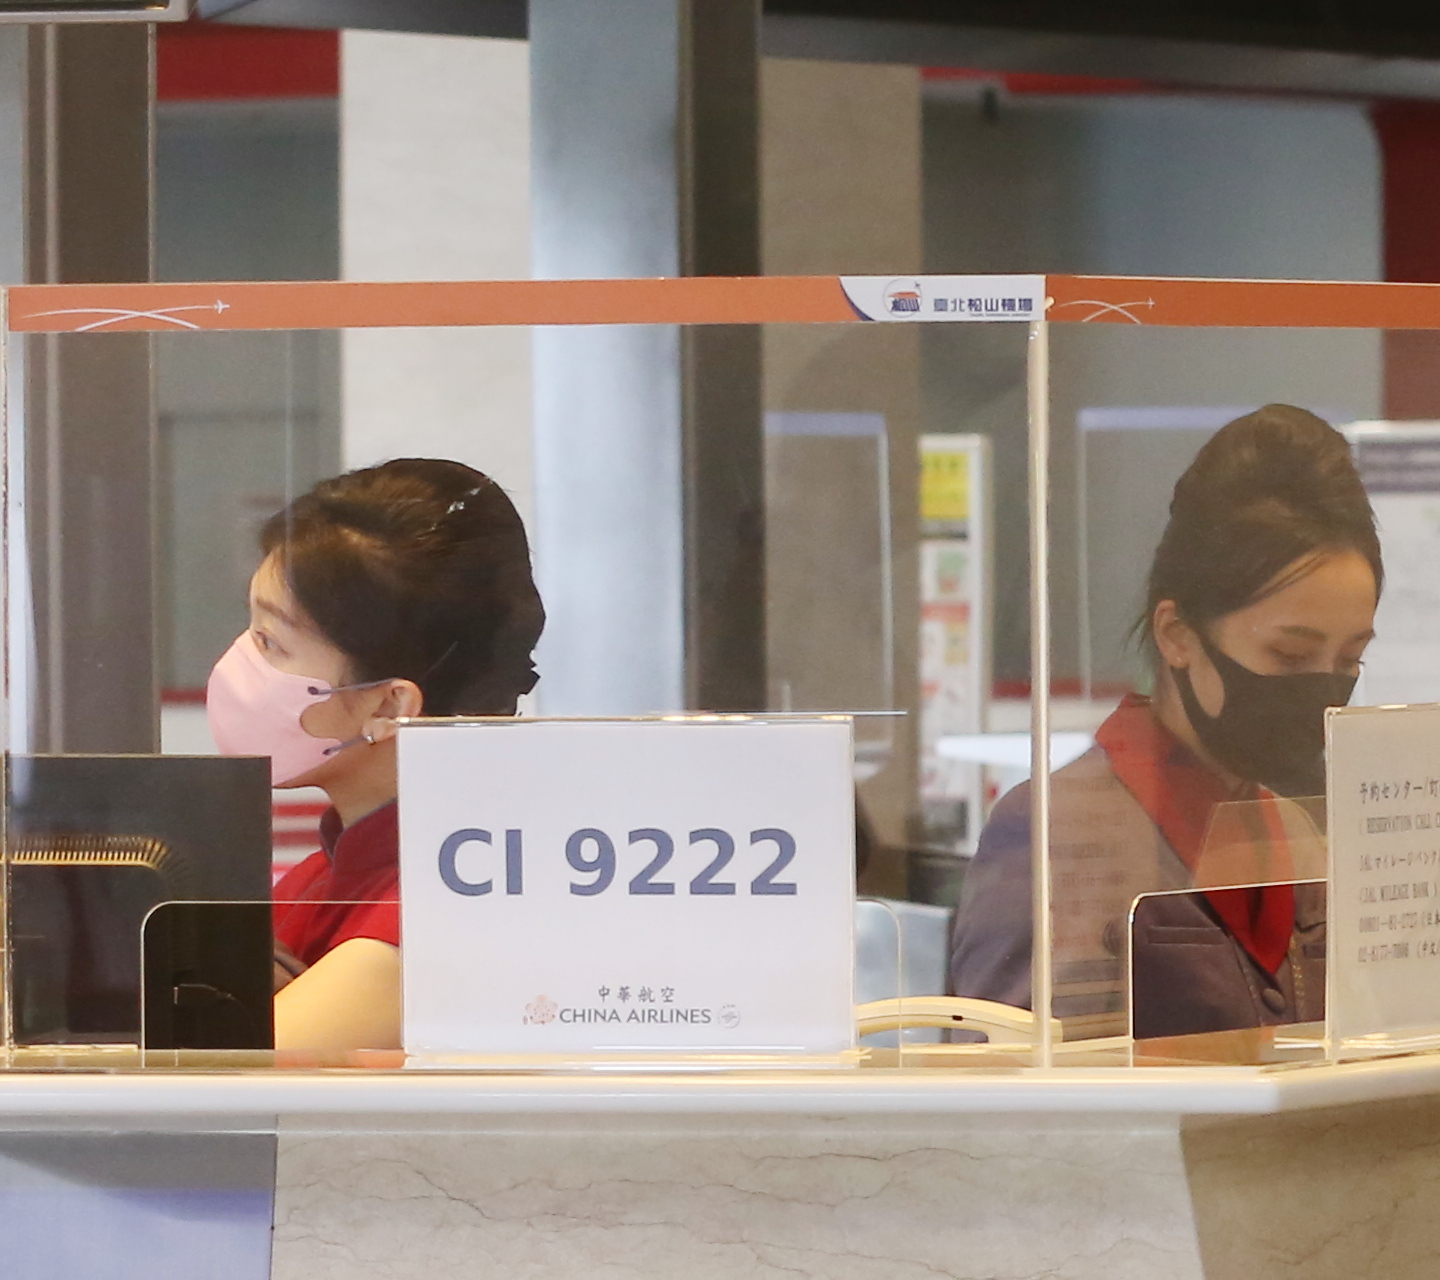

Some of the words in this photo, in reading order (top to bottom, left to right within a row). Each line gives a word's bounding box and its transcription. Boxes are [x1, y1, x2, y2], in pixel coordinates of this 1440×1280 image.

[437, 827, 524, 897] CI
[564, 827, 799, 897] 9222
[598, 985, 675, 1003] 中華航空
[559, 1008, 622, 1023] CHINA
[626, 1008, 712, 1023] AIRLINES
